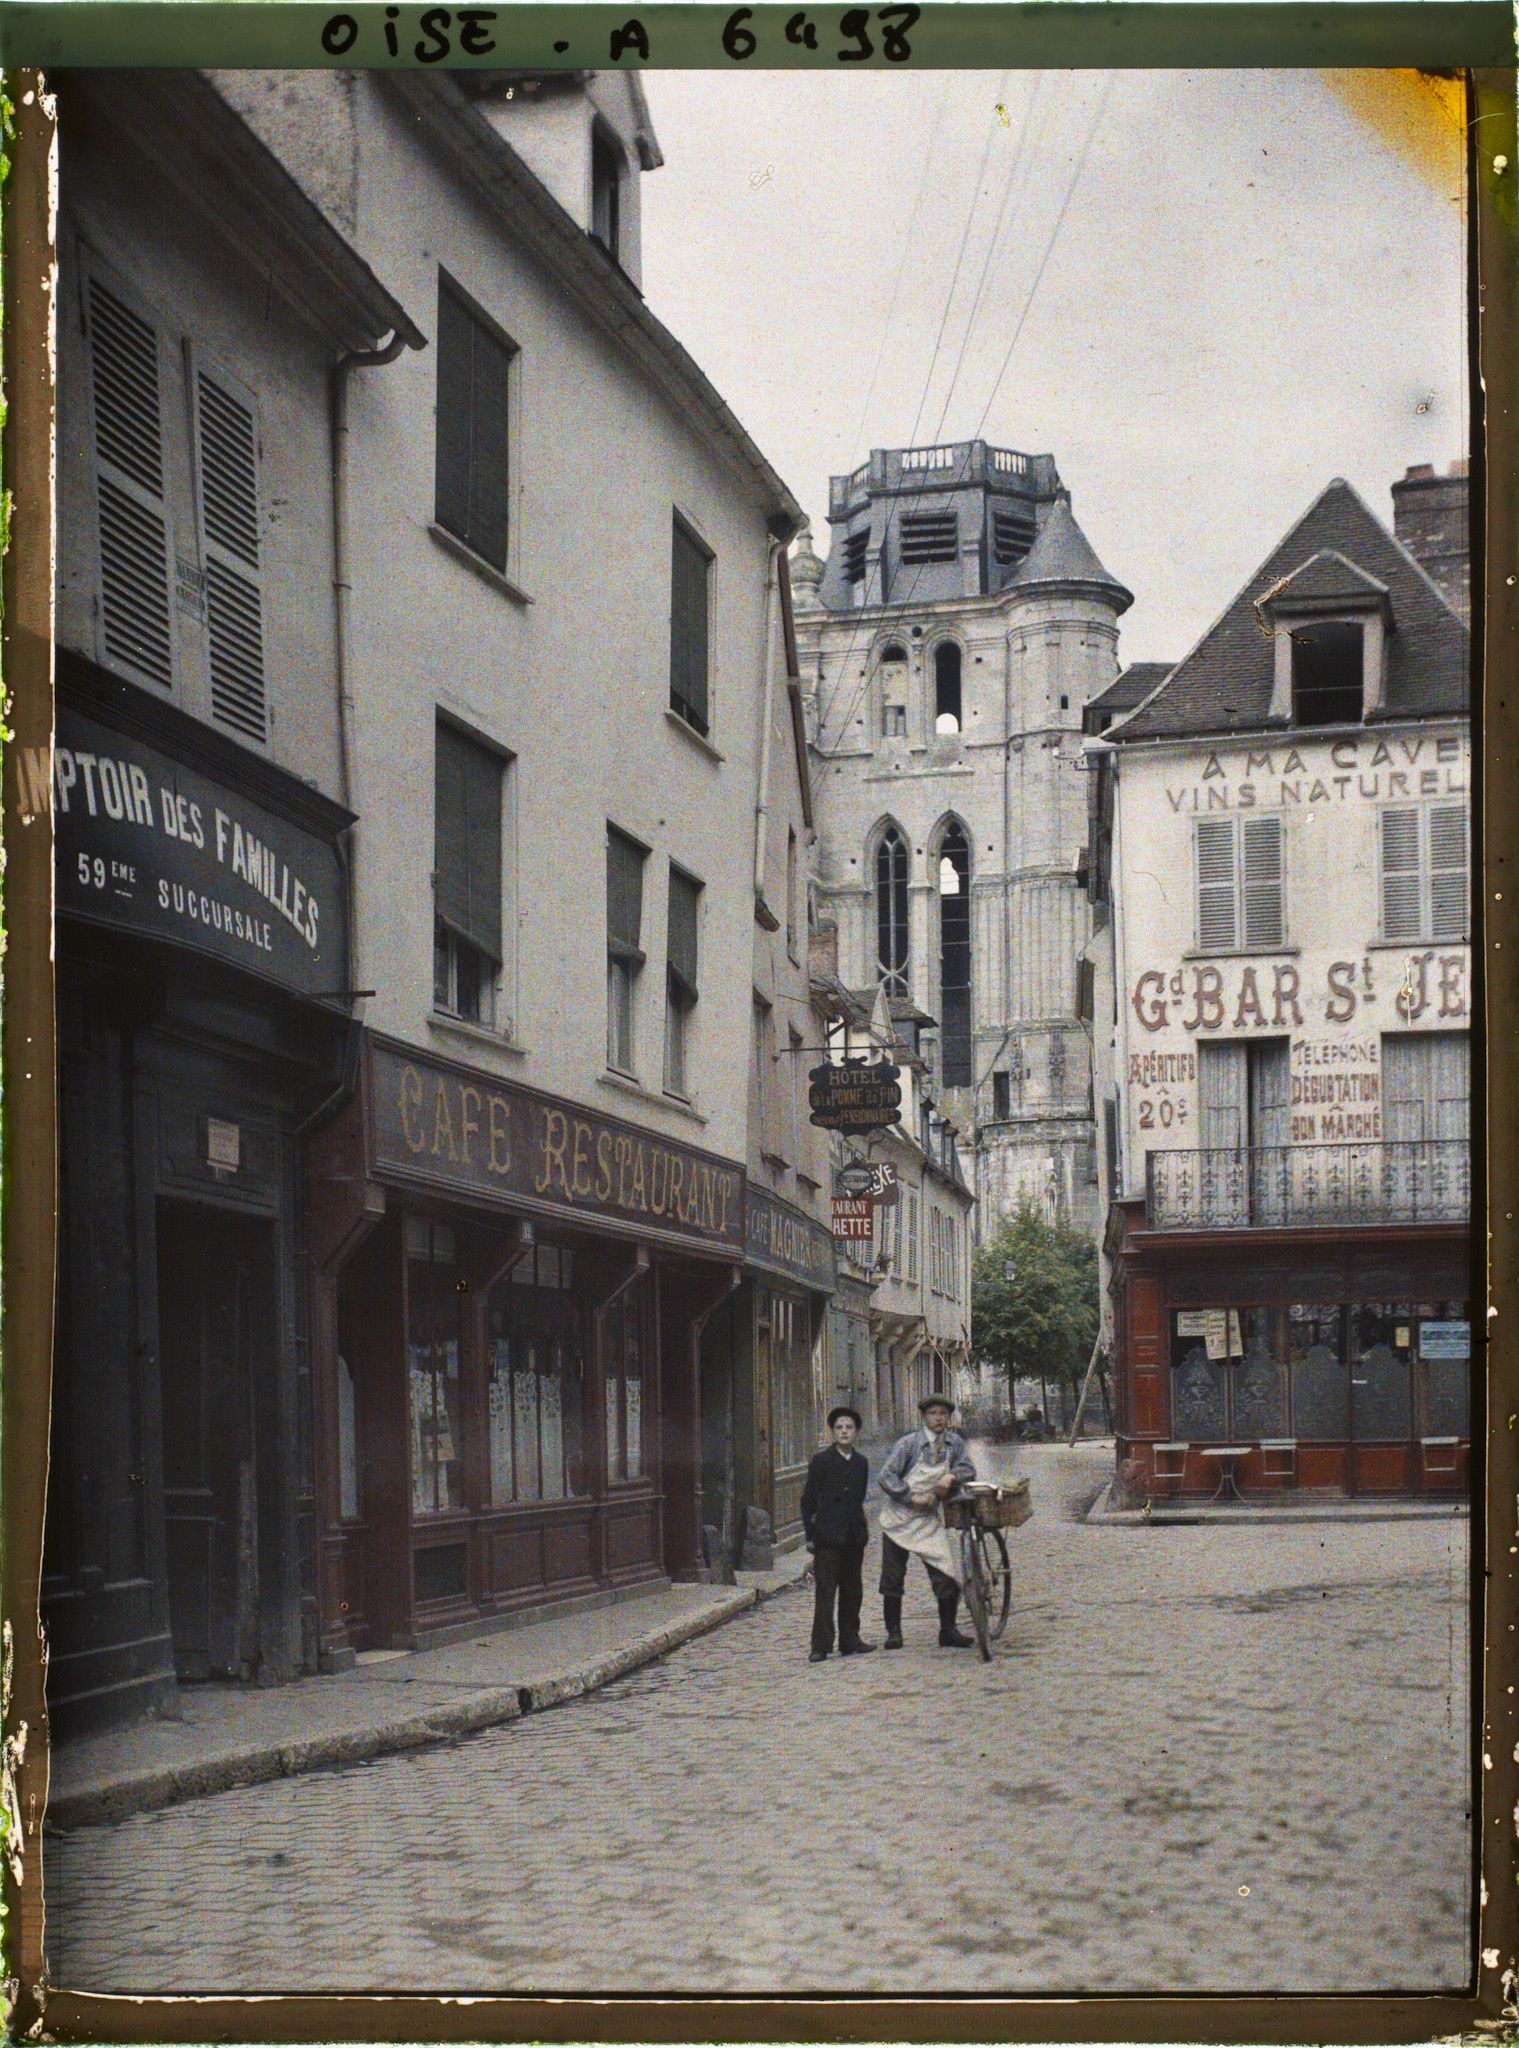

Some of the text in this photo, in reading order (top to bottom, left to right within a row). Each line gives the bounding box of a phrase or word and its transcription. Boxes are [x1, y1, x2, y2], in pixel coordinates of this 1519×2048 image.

[610, 19, 650, 60] A
[1245, 750, 1307, 777] MA
[1330, 738, 1460, 769] CAVE
[1166, 768, 1466, 813] VINS NATUREL
[160, 787, 205, 849] DES
[214, 807, 319, 949] FAMILLES
[158, 878, 272, 952] SUCCURSALE
[1182, 964, 1303, 1030] BAR
[1292, 1106, 1381, 1141] BON MARCHÉ
[398, 1064, 732, 1234] CAFE RESTAURANT
[833, 1217, 871, 1236] HETTE
